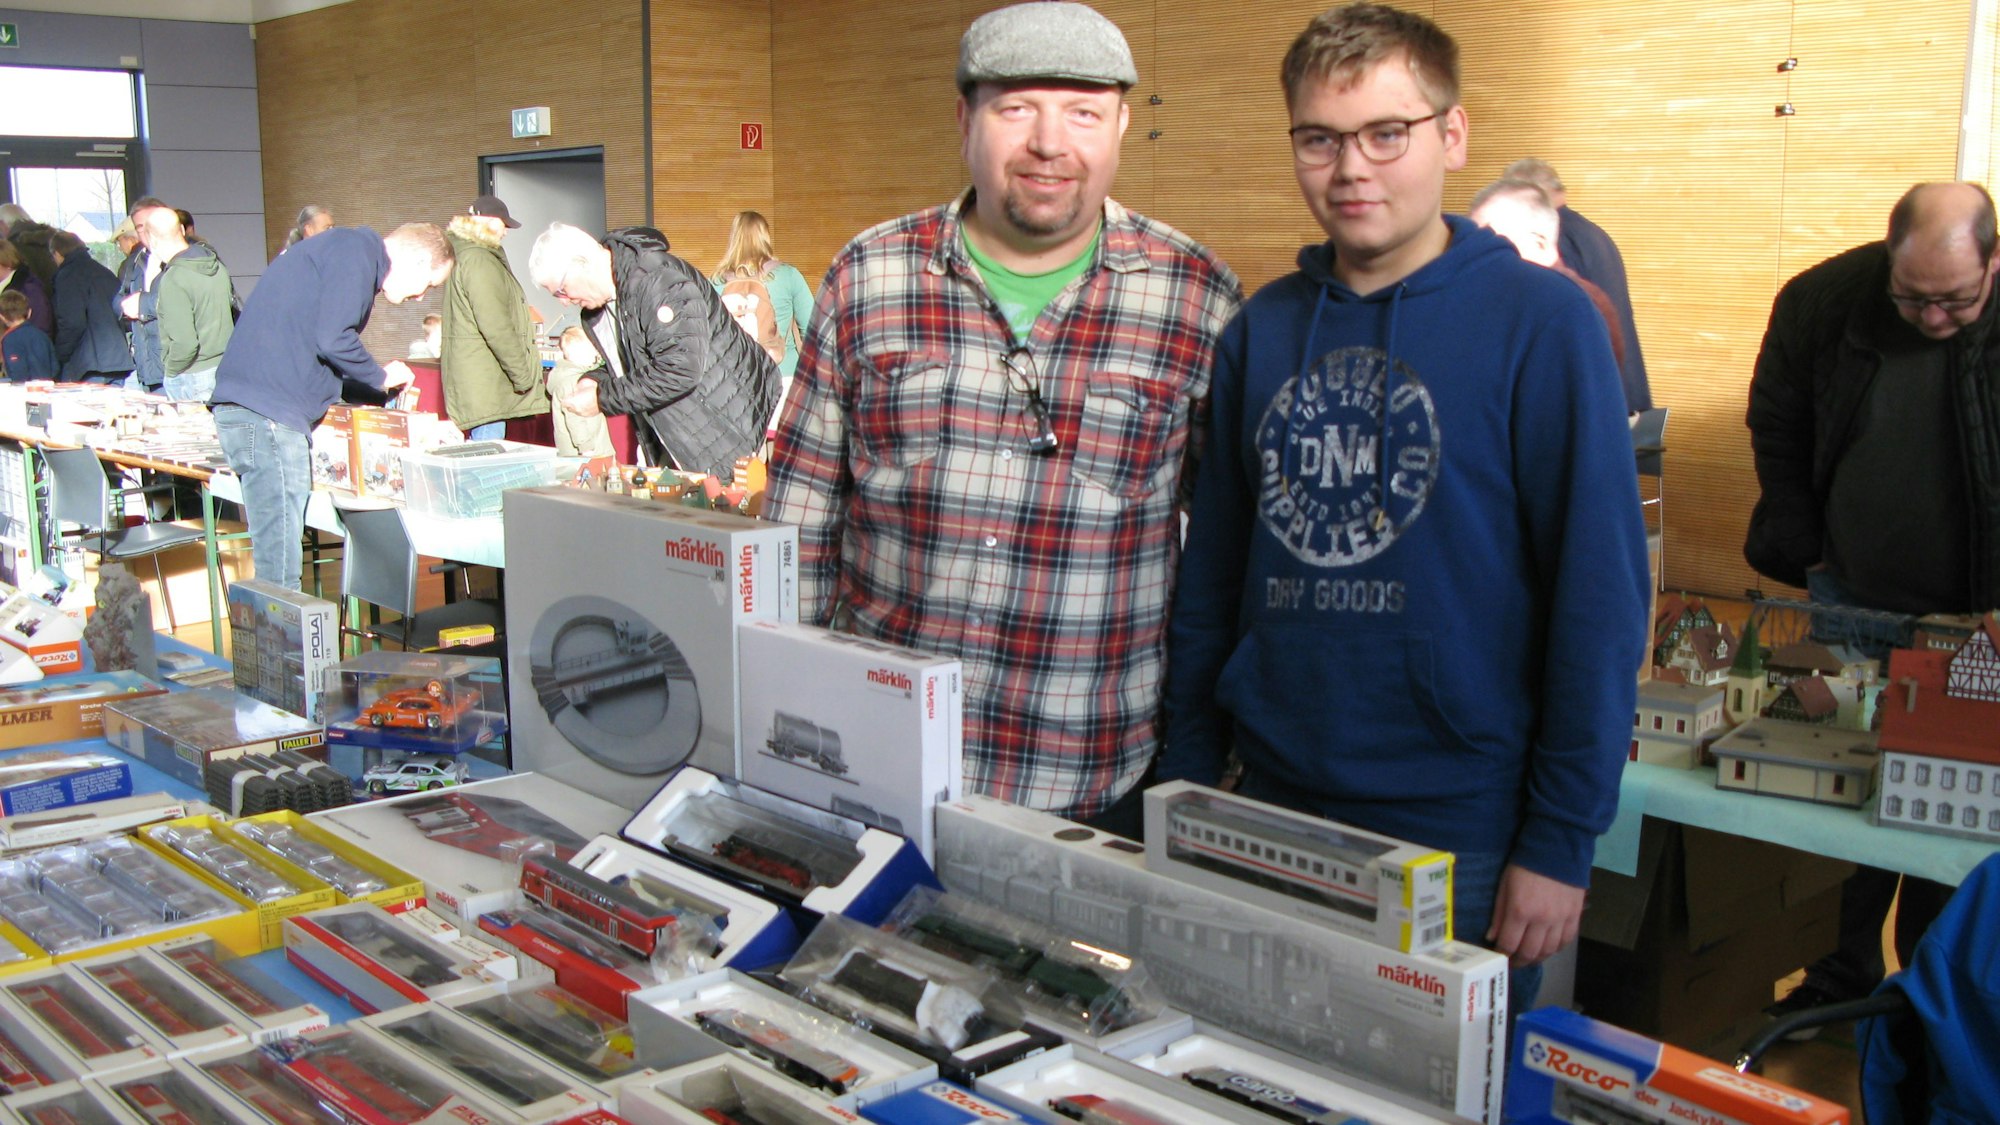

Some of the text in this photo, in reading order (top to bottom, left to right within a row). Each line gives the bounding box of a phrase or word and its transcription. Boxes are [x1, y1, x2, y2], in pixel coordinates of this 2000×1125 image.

[1299, 423, 1379, 488] DNM
[665, 537, 725, 568] märklin
[783, 540, 792, 567] 74861
[739, 544, 753, 613] märklin
[1266, 577, 1406, 614] DRY GOODS
[310, 617, 321, 659] POLA
[36, 652, 70, 664] Roco
[866, 668, 912, 691] märklin
[926, 676, 935, 719] märklin
[283, 736, 310, 750] FALLER
[1381, 867, 1405, 882] TRIX
[1377, 964, 1445, 997] märklin
[1545, 1045, 1630, 1092] Roco
[941, 1089, 1010, 1121] Roco
